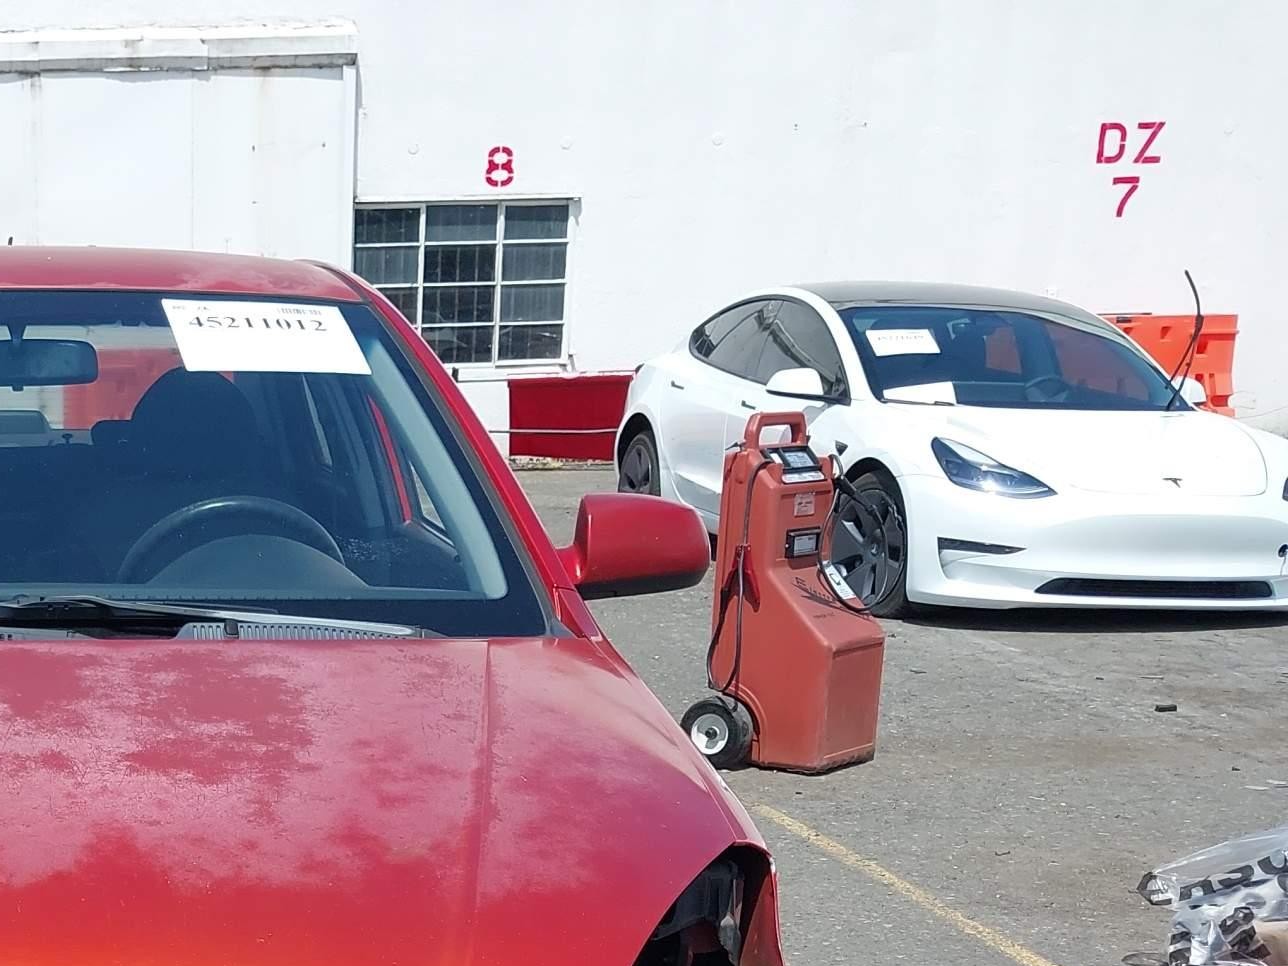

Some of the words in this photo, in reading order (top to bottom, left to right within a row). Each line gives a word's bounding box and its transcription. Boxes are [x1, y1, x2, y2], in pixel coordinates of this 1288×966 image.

[1096, 121, 1166, 164] DZ
[485, 146, 514, 187] 8
[1112, 175, 1140, 217] 7
[188, 315, 328, 332] 45211012
